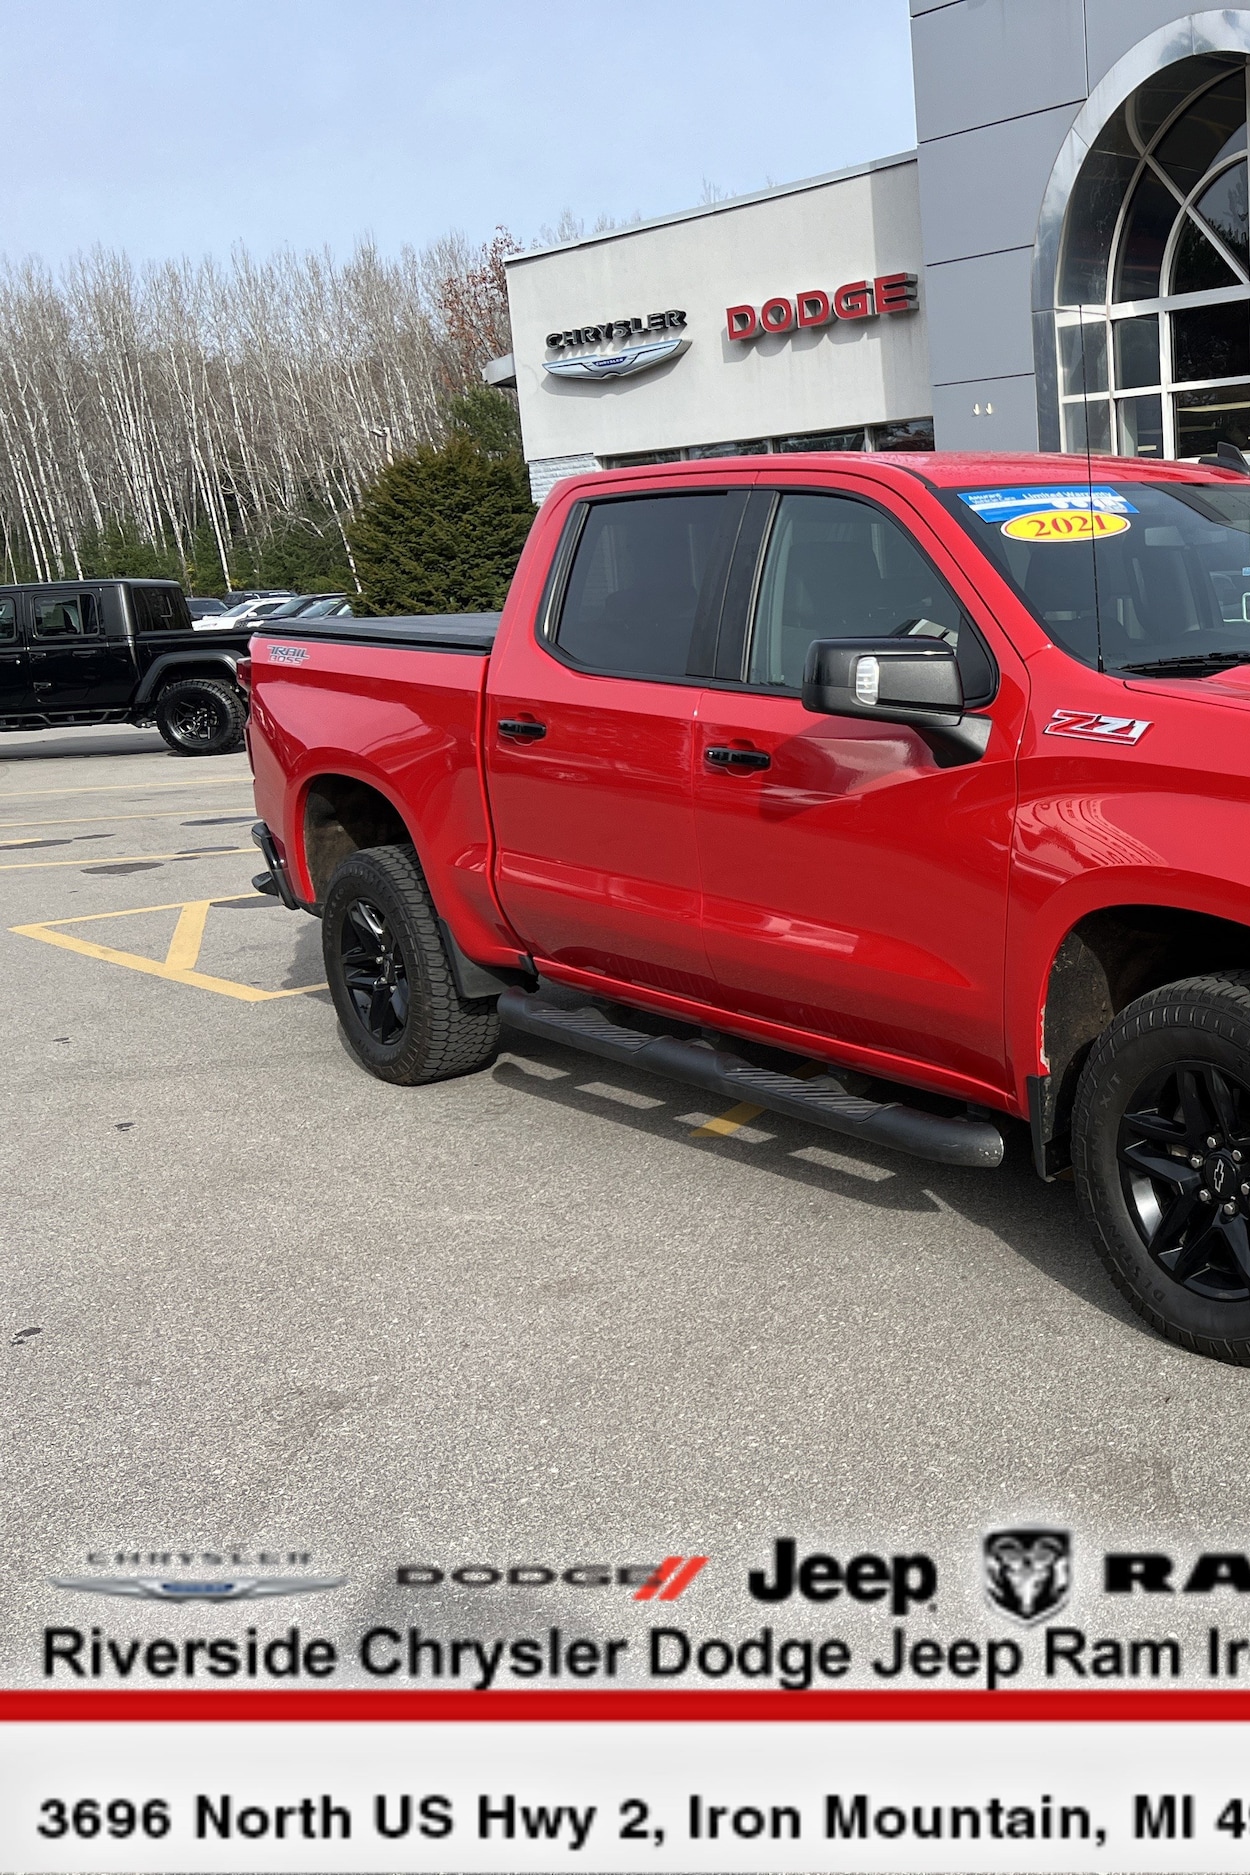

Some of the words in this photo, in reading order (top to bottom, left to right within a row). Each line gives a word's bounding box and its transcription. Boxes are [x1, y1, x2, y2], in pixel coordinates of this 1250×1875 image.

[726, 272, 919, 341] DODGE
[545, 309, 687, 350] CHRYSLER
[1027, 514, 1108, 538] 2021
[267, 645, 309, 659] TRAIL
[269, 655, 303, 665] BOSS
[1043, 709, 1154, 746] Z71
